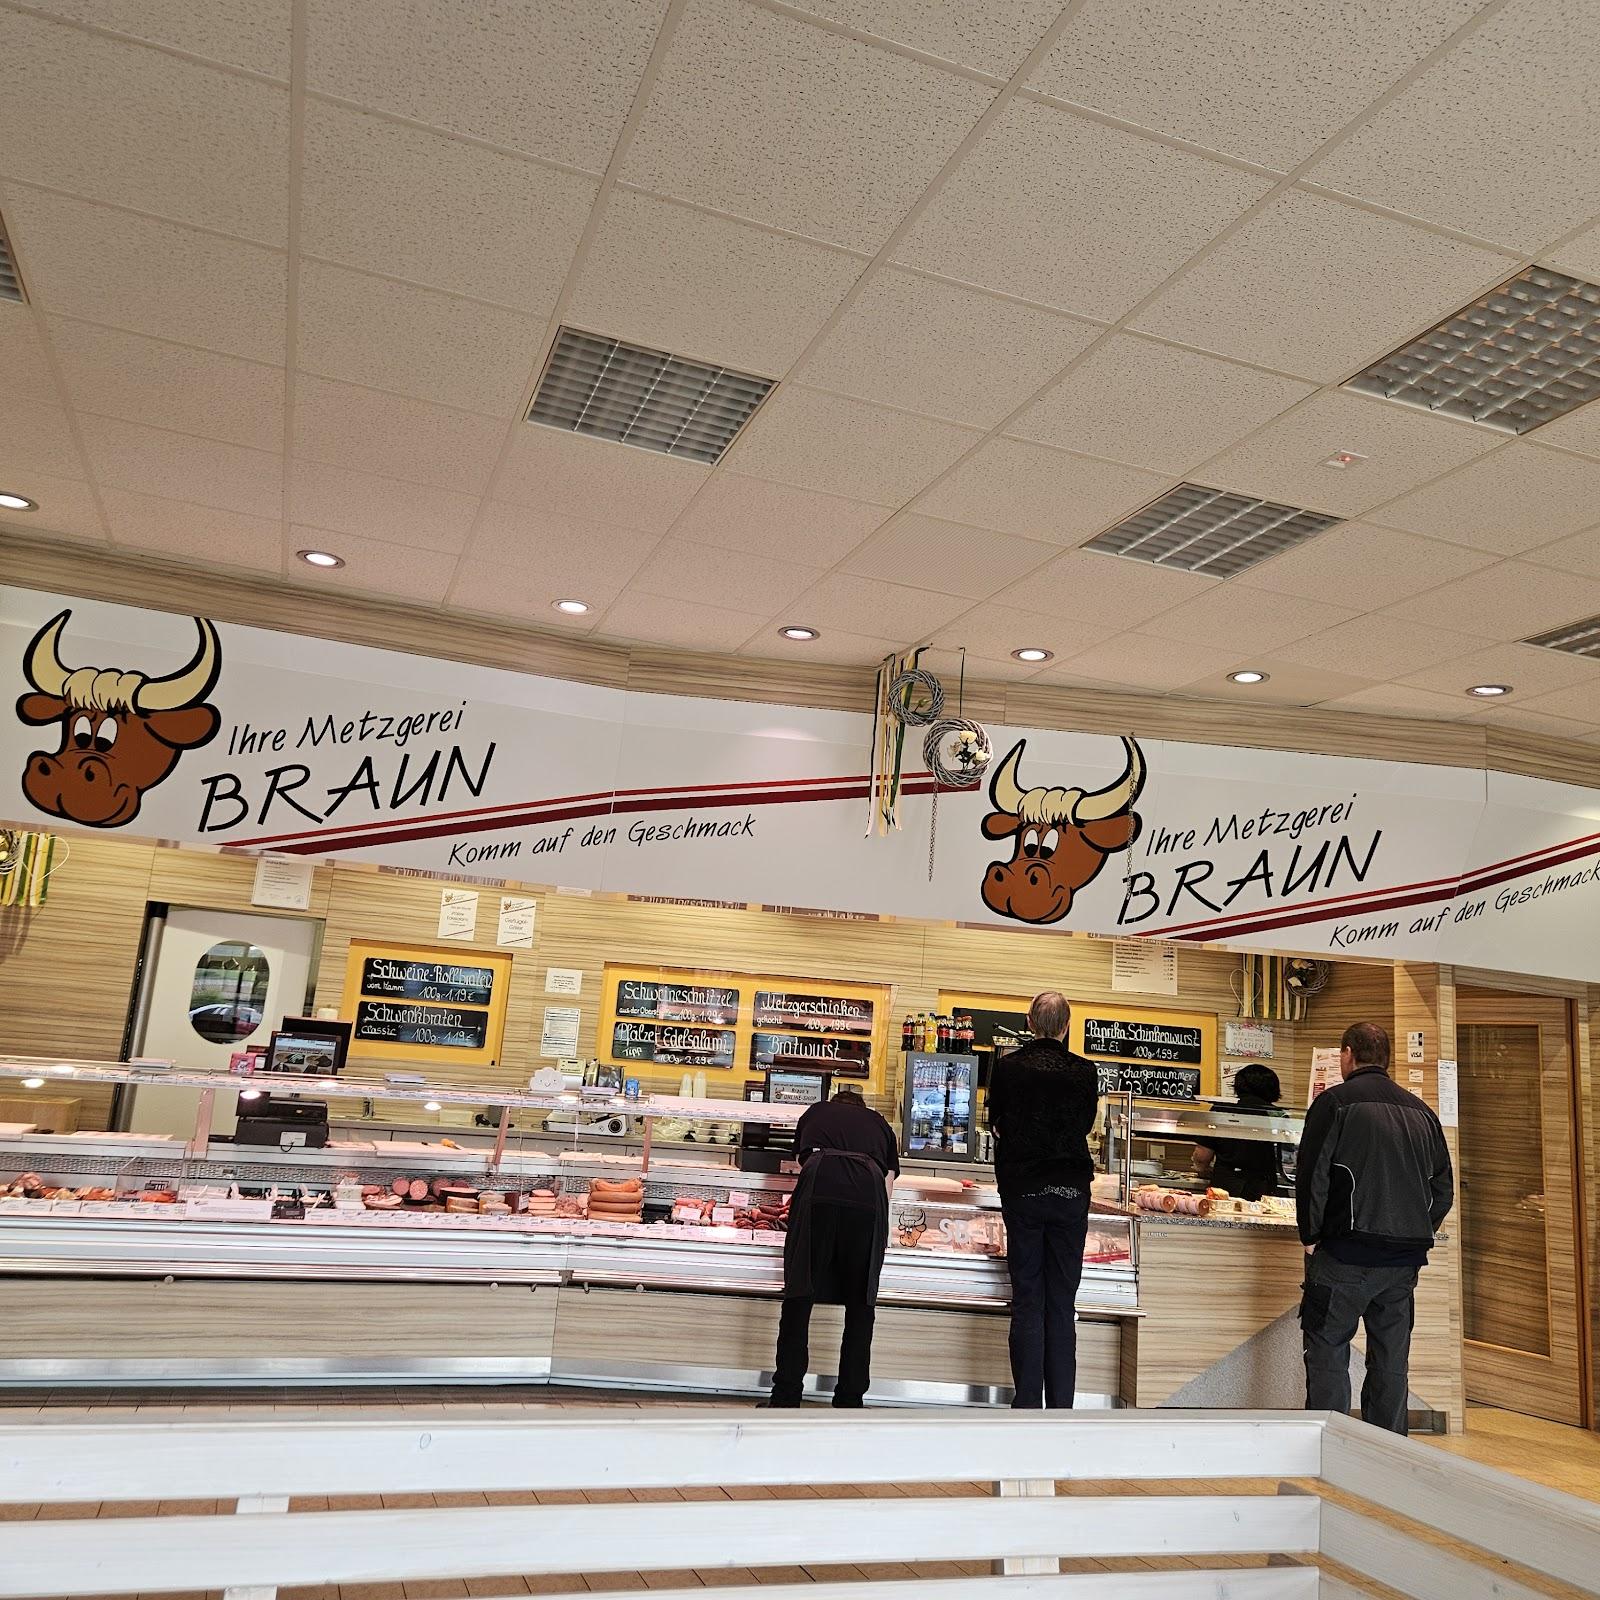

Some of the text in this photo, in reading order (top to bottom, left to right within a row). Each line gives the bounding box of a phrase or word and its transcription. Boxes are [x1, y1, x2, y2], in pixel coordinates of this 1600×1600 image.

[228, 700, 467, 755] Ihre Metzgerei
[197, 742, 497, 833] BRAUN
[1146, 793, 1358, 857] Ihre Metzgerei
[448, 813, 757, 867] Komm auf den Geschmack
[1116, 829, 1383, 925] BRAUN
[1329, 860, 1600, 947] Komm auf den Geschmack
[624, 982, 733, 1007] Schweineschnitzel
[762, 991, 861, 1018] Metzgerschinken
[367, 1003, 462, 1027] Schwenkbraten
[663, 1027, 728, 1052] Edelsalami
[768, 1035, 840, 1059] Bratwurst
[1087, 1019, 1200, 1047] Paprika-Schinkenwurst
[1091, 1040, 1107, 1051] mit
[1108, 1041, 1120, 1052] Ei
